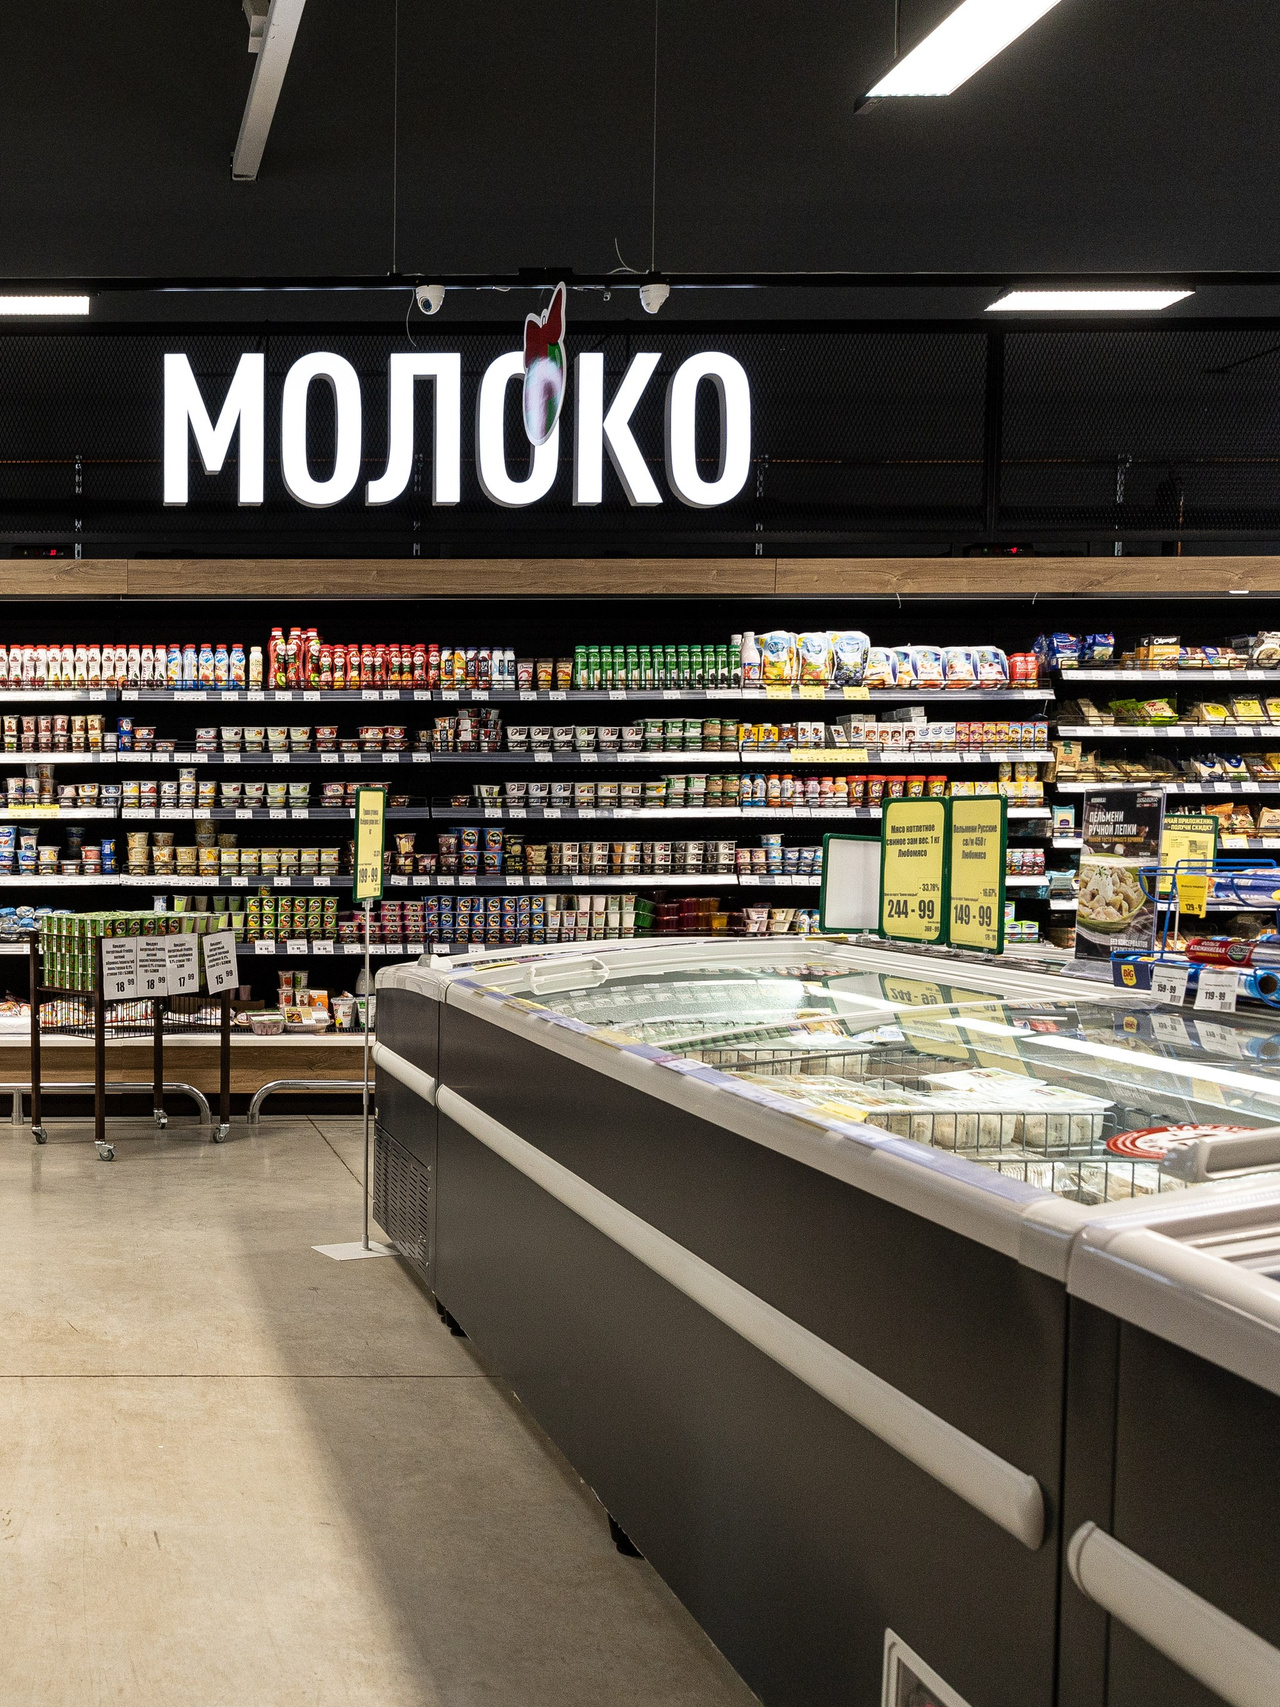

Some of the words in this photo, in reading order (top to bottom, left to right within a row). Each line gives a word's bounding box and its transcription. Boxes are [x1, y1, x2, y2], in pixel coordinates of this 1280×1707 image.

[163, 352, 751, 508] МОЛОКО
[1089, 811, 1124, 822] ПЕЛЬМЕНИ
[891, 825, 905, 834] Мясо
[906, 824, 935, 833] котлетное
[953, 825, 977, 833] Пельмени
[978, 824, 997, 833] Русские
[1089, 822, 1113, 835] РУЧНОЙ
[1114, 824, 1137, 835] ЛЕПКИ
[886, 838, 906, 846] свиное
[907, 837, 918, 846] зам
[918, 837, 930, 845] вес.
[934, 836, 940, 845] кг
[897, 849, 928, 858] Любомясо
[962, 850, 986, 860] Любомясо
[359, 868, 368, 883] 199
[371, 868, 378, 882] 99
[888, 899, 909, 918] 244
[918, 900, 934, 919] 99
[1185, 903, 1194, 911] 129
[954, 904, 970, 925] 149
[978, 905, 992, 927] 99
[147, 979, 155, 989] 18
[178, 977, 185, 987] 17
[215, 974, 223, 985] 15
[116, 981, 125, 992] 18
[1158, 984, 1166, 992] 159
[1169, 985, 1176, 994] 99
[1205, 991, 1214, 1000] 119
[1218, 992, 1226, 1000] 99
